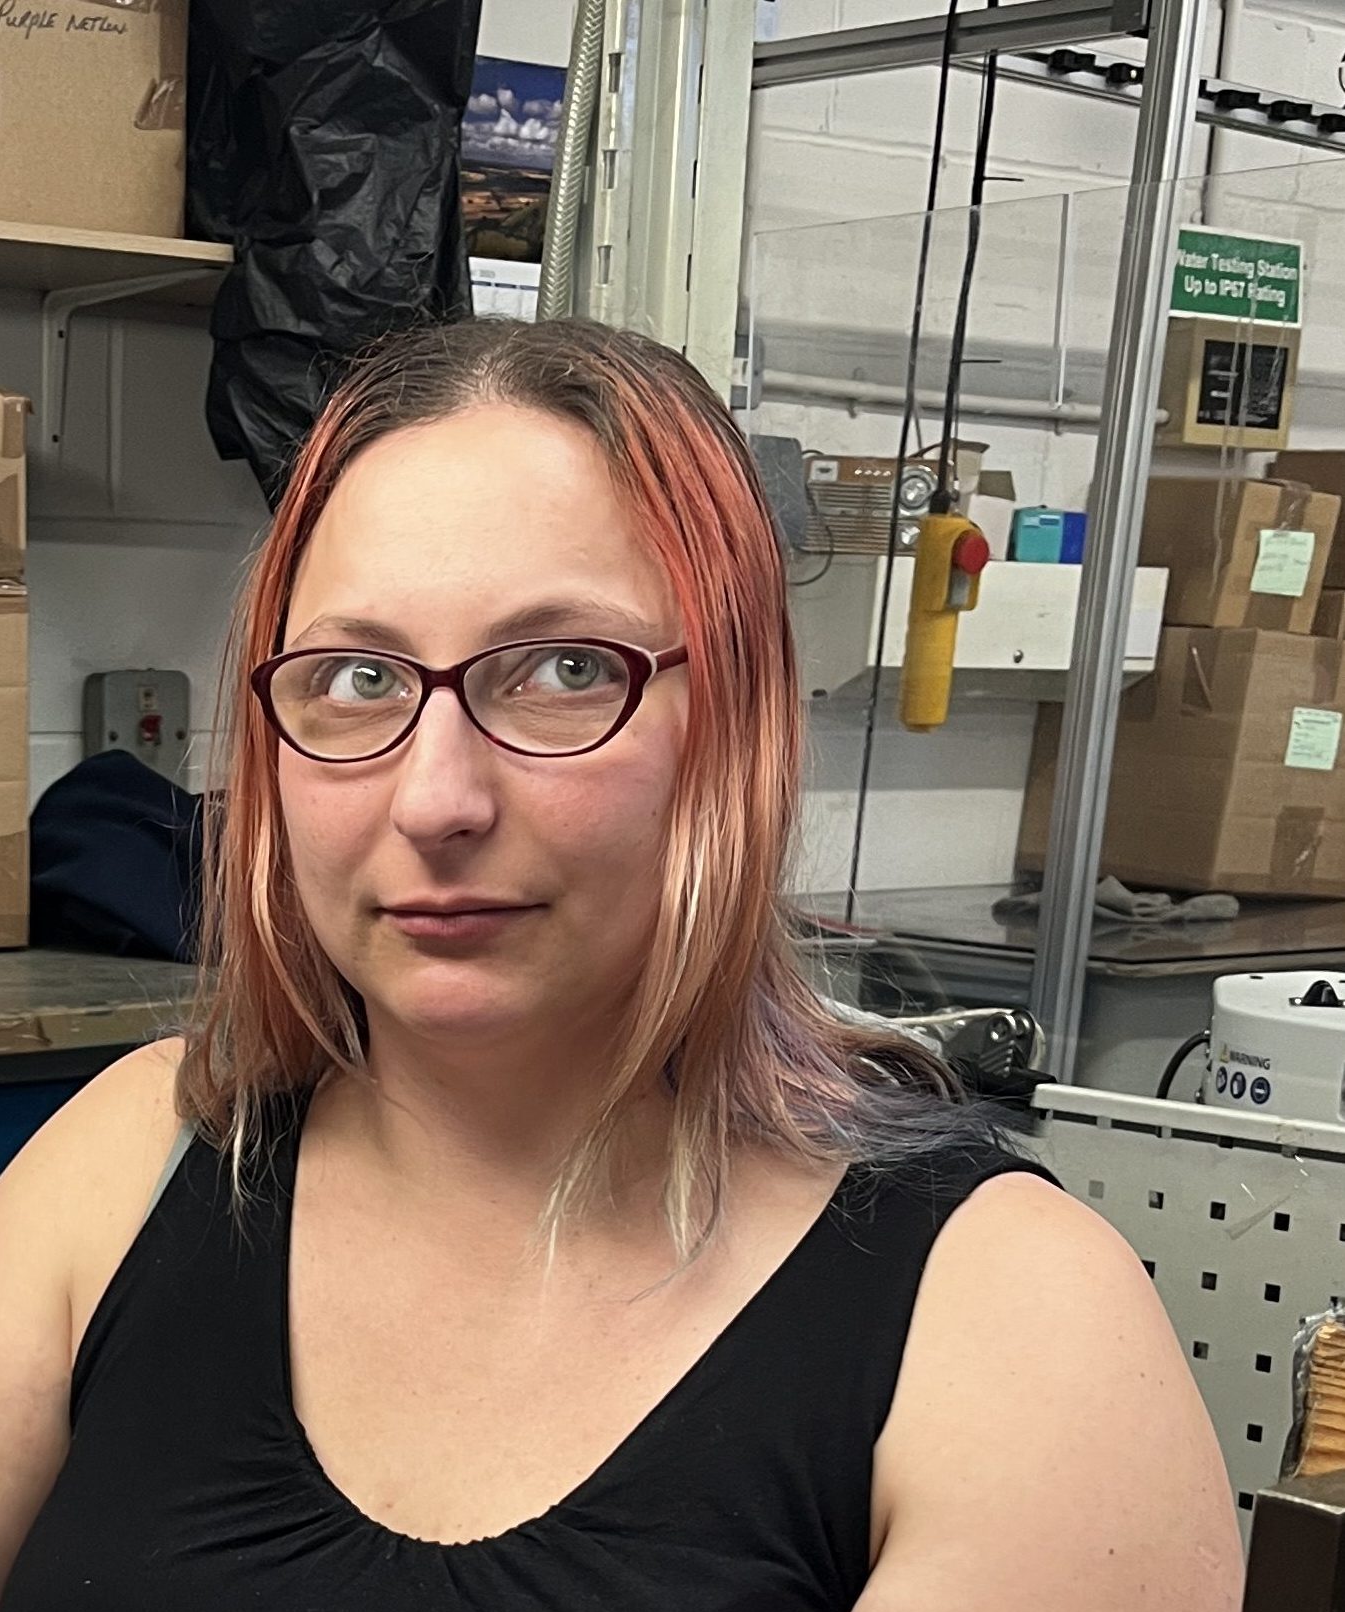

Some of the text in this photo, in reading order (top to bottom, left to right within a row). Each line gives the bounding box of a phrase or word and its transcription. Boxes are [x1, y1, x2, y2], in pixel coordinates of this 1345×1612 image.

[1211, 254, 1255, 279] Testing
[1257, 259, 1297, 280] Station
[1184, 276, 1202, 297] Up
[1205, 278, 1217, 296] to
[1248, 283, 1285, 307] Rating
[1230, 1050, 1270, 1070] WARNING
